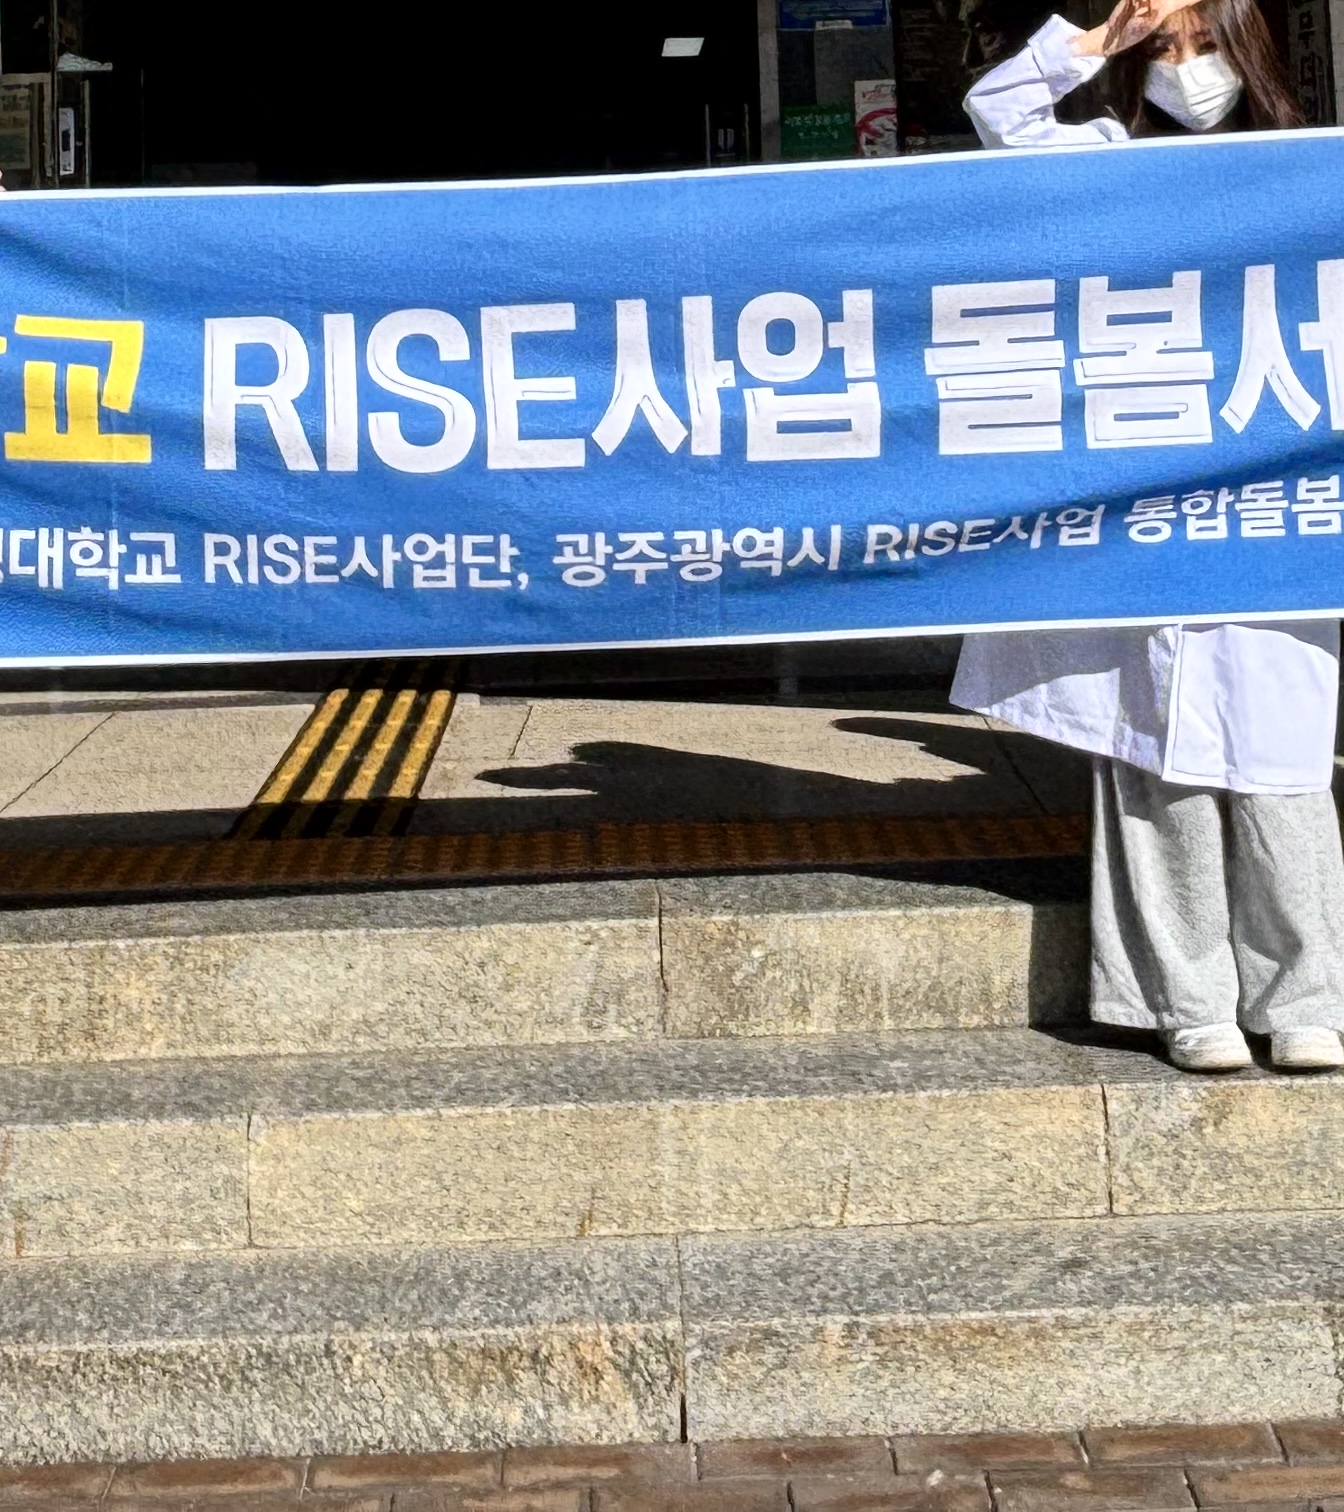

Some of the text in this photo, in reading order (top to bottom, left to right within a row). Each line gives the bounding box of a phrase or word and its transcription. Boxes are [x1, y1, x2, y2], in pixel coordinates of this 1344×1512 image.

[203, 289, 882, 474] RISE사업
[204, 532, 529, 591] RISE사업단,
[553, 524, 842, 588] 광주광역시
[863, 504, 1105, 565] RISE사업
